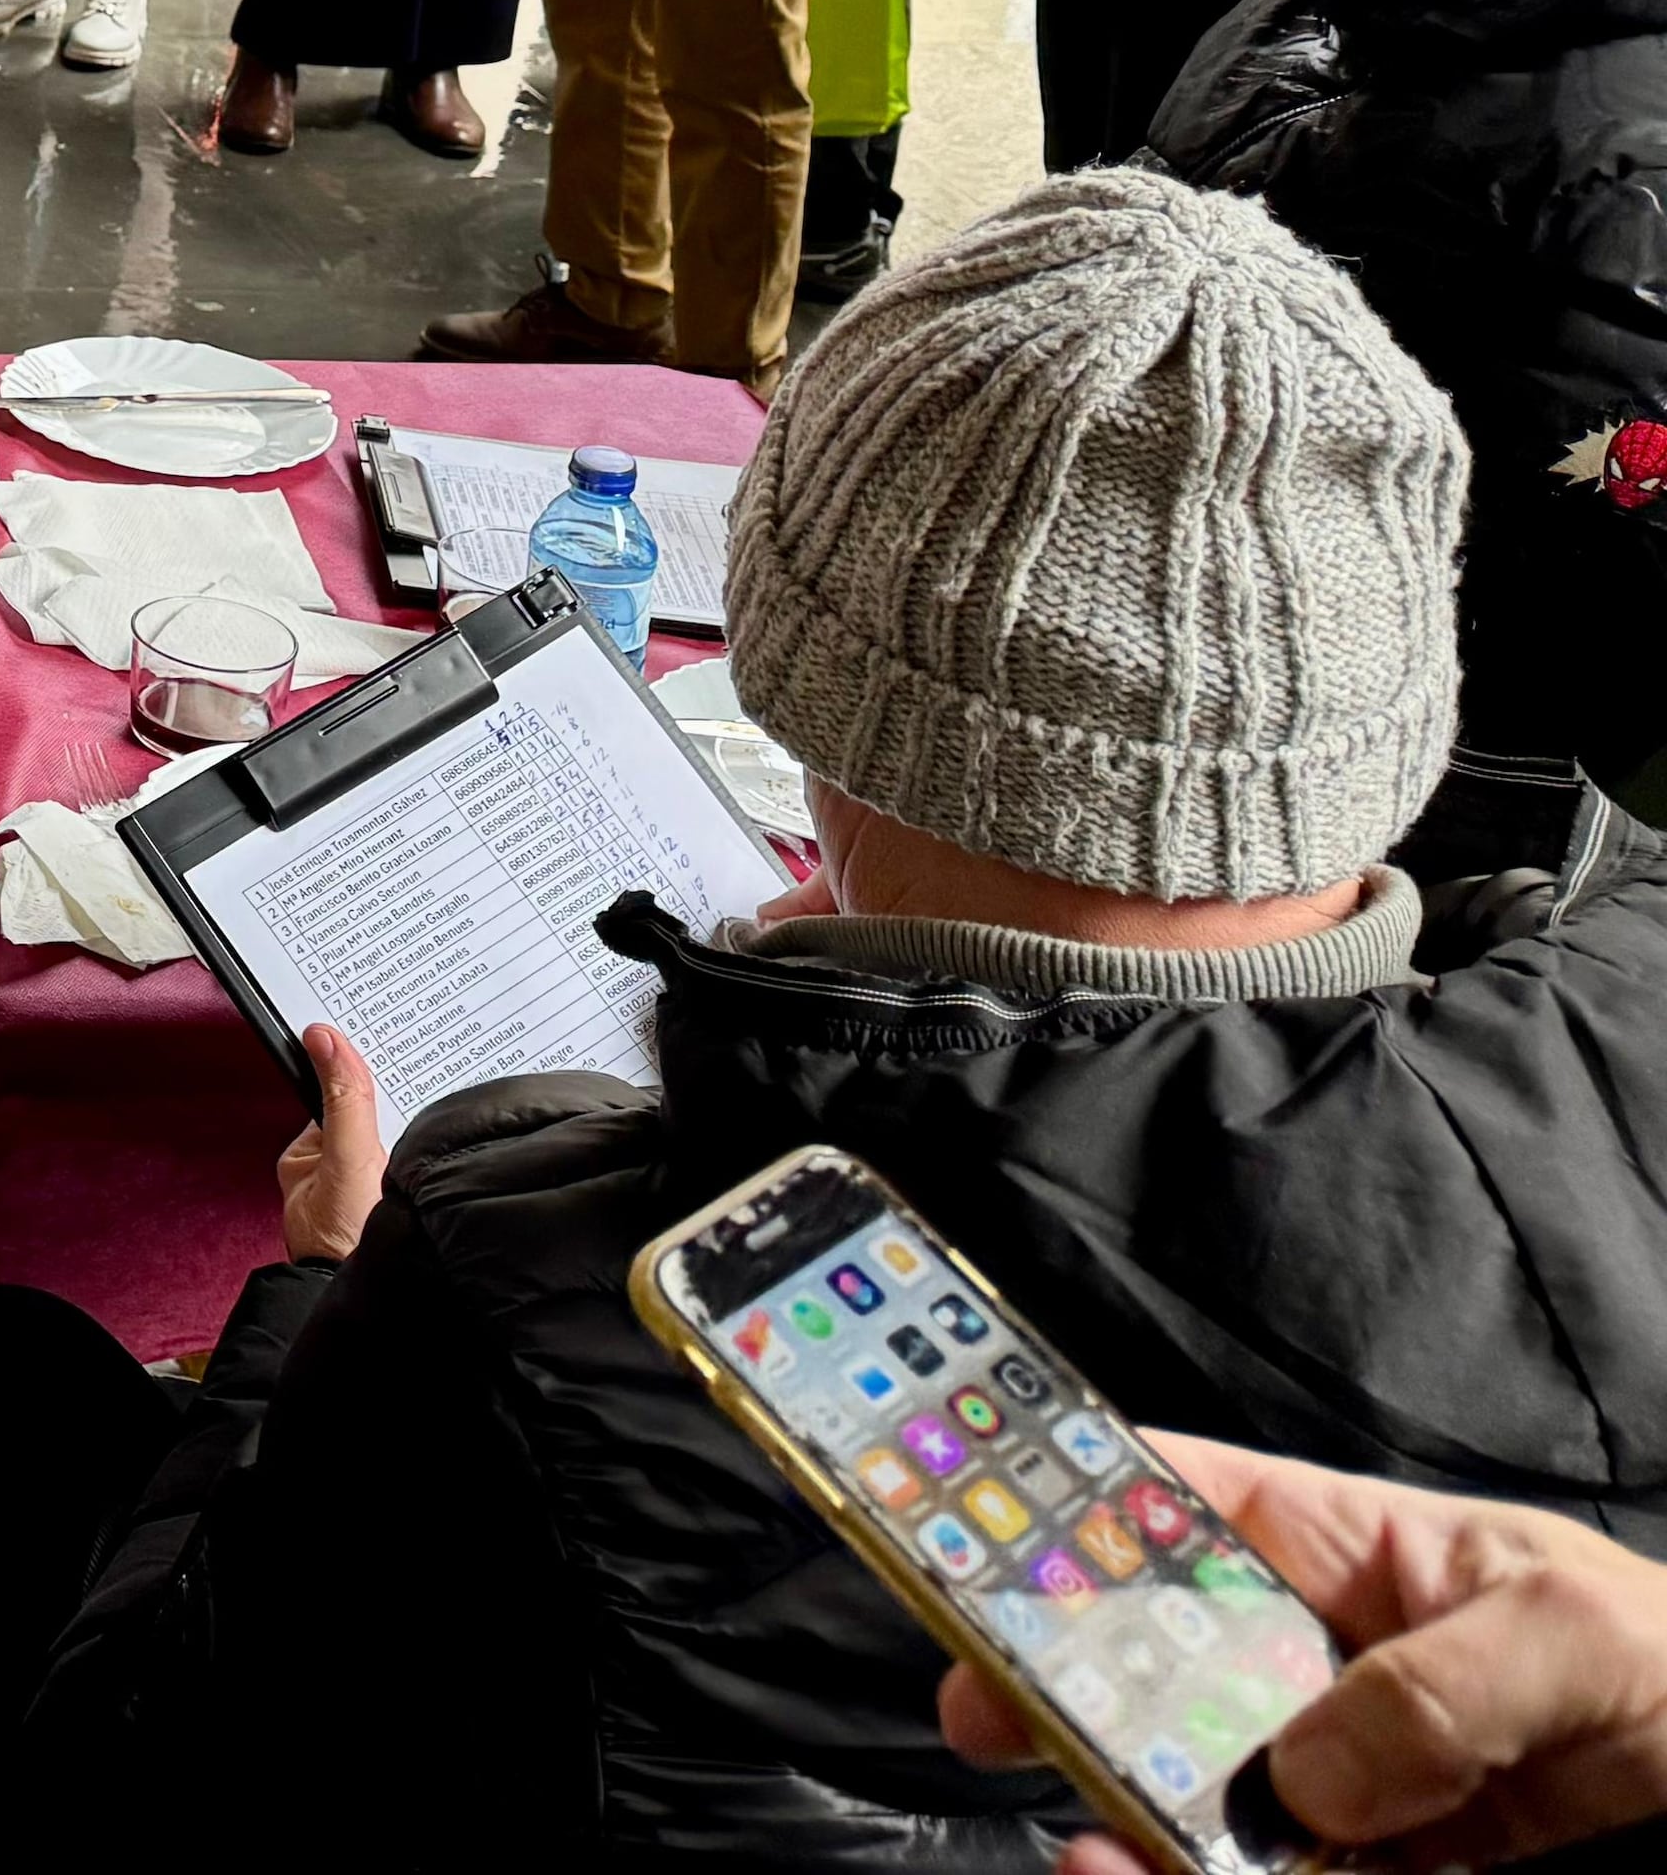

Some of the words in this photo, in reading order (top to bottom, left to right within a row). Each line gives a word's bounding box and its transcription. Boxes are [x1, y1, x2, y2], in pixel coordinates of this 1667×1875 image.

[253, 889, 266, 902] 1
[266, 869, 295, 893] José
[290, 845, 335, 879] Enrique
[330, 806, 395, 853] Trasmontan
[389, 785, 429, 815] Gálvez
[266, 906, 280, 920] 2
[296, 867, 343, 902] Angeles
[337, 851, 365, 874] Miro
[361, 826, 406, 859] Herranz
[452, 757, 514, 801] 669939565
[279, 924, 293, 938] 3
[293, 888, 349, 928] Francisco
[344, 867, 382, 896] Benito
[377, 845, 417, 875] Gracia
[412, 822, 453, 853] Lozano
[465, 775, 527, 819] 691842484
[292, 942, 306, 956] 4
[306, 914, 350, 947] Vanesa
[345, 894, 380, 922] Calvo
[375, 867, 423, 903] Secorun
[478, 792, 541, 837] 659889292
[305, 961, 319, 974] 5
[320, 941, 349, 965] Pilar
[388, 885, 437, 921] Bandrés
[492, 810, 555, 855] 645861286
[318, 979, 332, 993] 6
[349, 945, 386, 975] Angel
[379, 918, 430, 956] Lospaus
[423, 890, 473, 928] Gargallo
[506, 828, 568, 872] 660135762
[332, 997, 345, 1011] 7
[363, 962, 400, 991] Isabel
[395, 939, 436, 971] Estallo
[431, 914, 476, 948] Benues
[520, 846, 582, 891] 665909950
[344, 1016, 359, 1031] 8
[359, 995, 390, 1021] Felix
[385, 965, 437, 1004] Encontra
[431, 943, 471, 974] Atarés
[534, 864, 596, 908] 699978880
[358, 1035, 372, 1049] 9
[389, 1005, 419, 1029] Pilar
[414, 983, 454, 1015] Capuz
[448, 959, 490, 991] Labata
[548, 882, 610, 926] 625692323
[369, 1052, 388, 1069] 10
[385, 1031, 419, 1058] Petru
[414, 1000, 467, 1040] Alcatrine
[383, 1071, 402, 1088] 11
[399, 1045, 441, 1077] Nieves
[436, 1017, 485, 1055] Puyuelo
[396, 1089, 416, 1107] 12
[413, 1068, 447, 1096] Berta
[442, 1052, 473, 1077] Bara
[467, 1017, 527, 1061] Santolaria
[495, 1045, 526, 1070] Bara
[603, 960, 657, 1000] 6698082
[536, 1040, 577, 1073] Alegre
[617, 982, 666, 1019] 6102211
